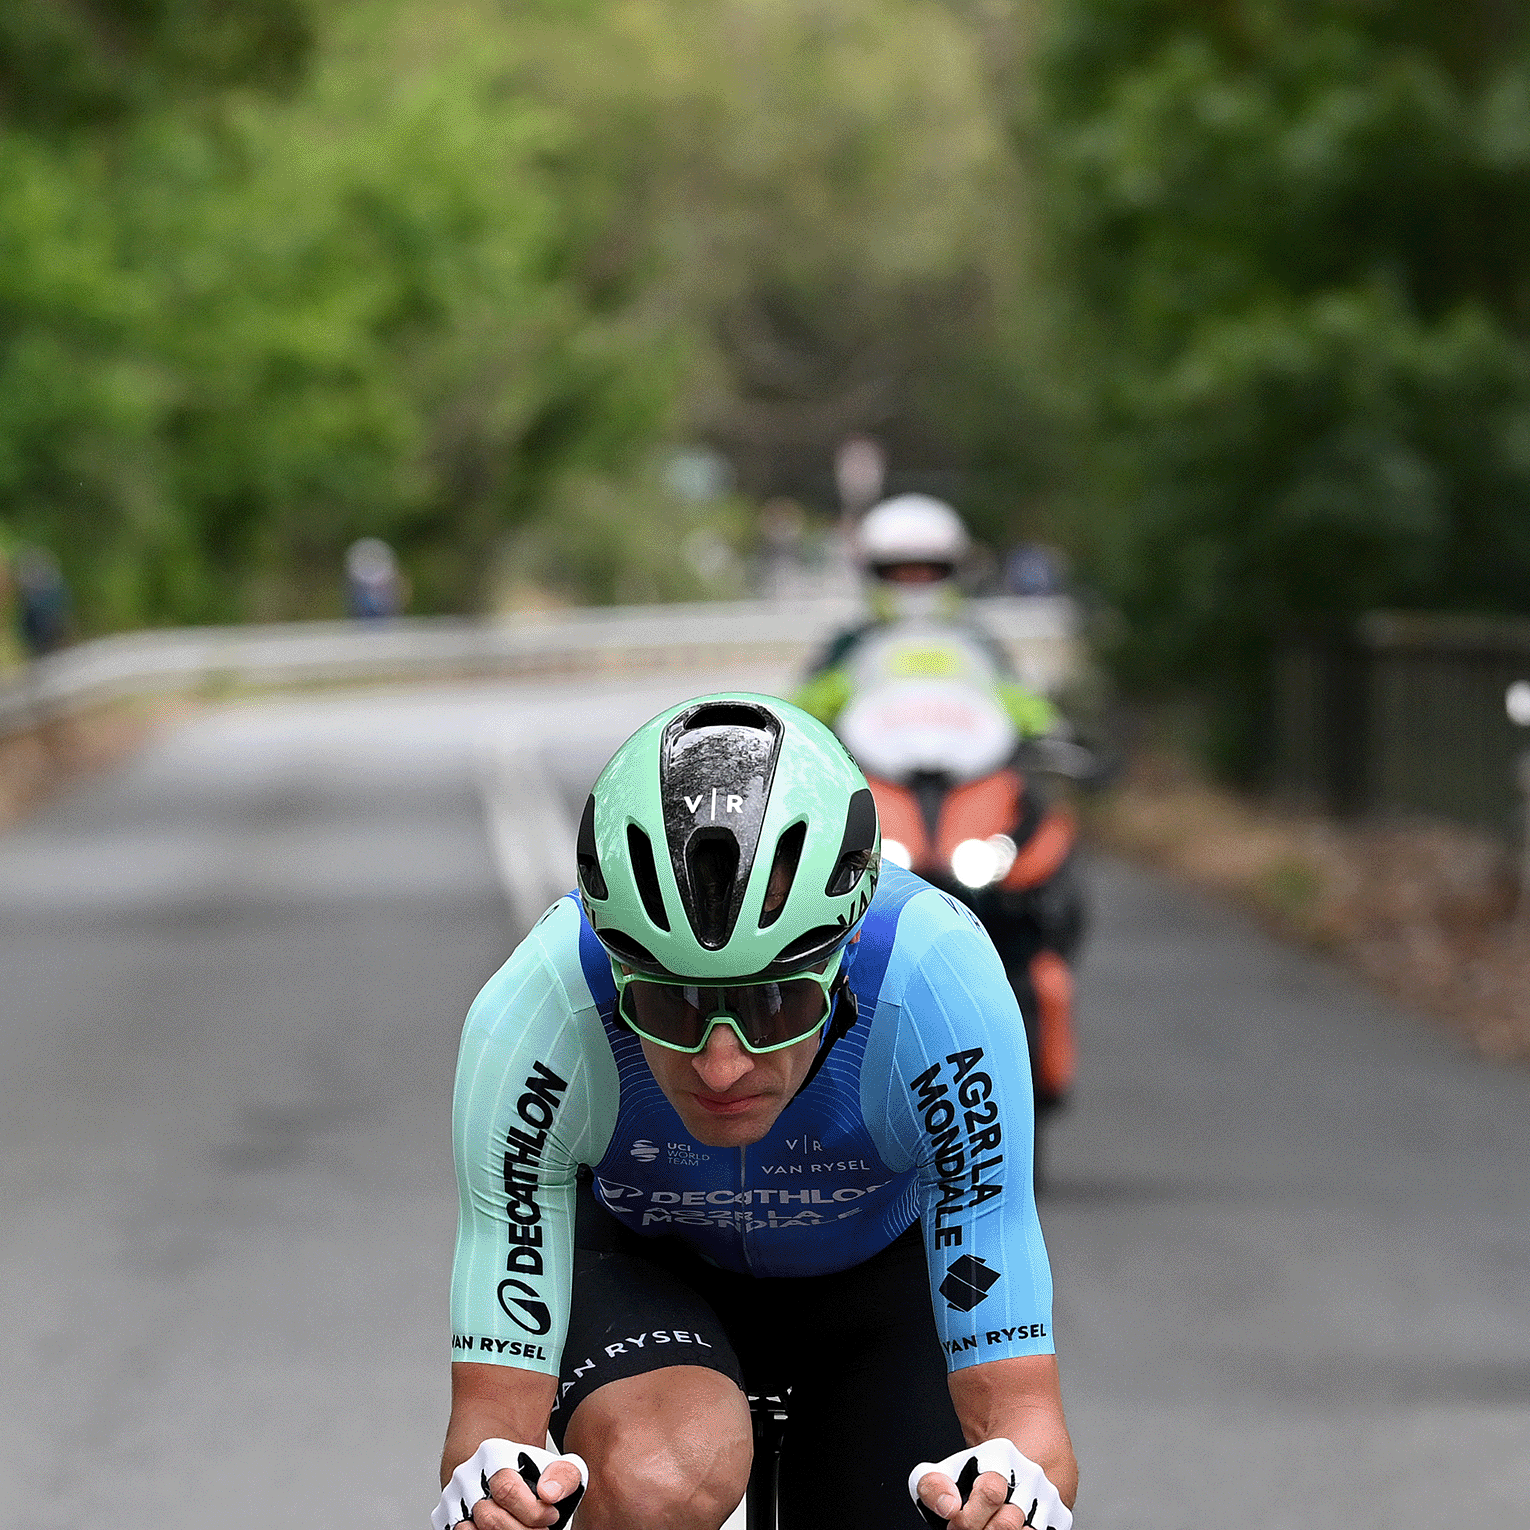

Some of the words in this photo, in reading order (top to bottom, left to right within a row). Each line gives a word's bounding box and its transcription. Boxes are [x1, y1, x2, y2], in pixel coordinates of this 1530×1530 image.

[667, 1142, 691, 1152] UCI
[667, 1150, 710, 1161] WORLD
[910, 1062, 965, 1251] MONDIALE
[503, 1060, 569, 1276] DECATHLON
[668, 1157, 699, 1167] TEAM
[761, 1164, 803, 1174] VAN
[811, 1159, 871, 1173] RYSEL
[767, 1210, 823, 1220] LA
[604, 1330, 713, 1359] RYSEL
[942, 1334, 978, 1355] VAN
[985, 1323, 1047, 1345] RYSEL
[479, 1337, 547, 1361] RYSEL
